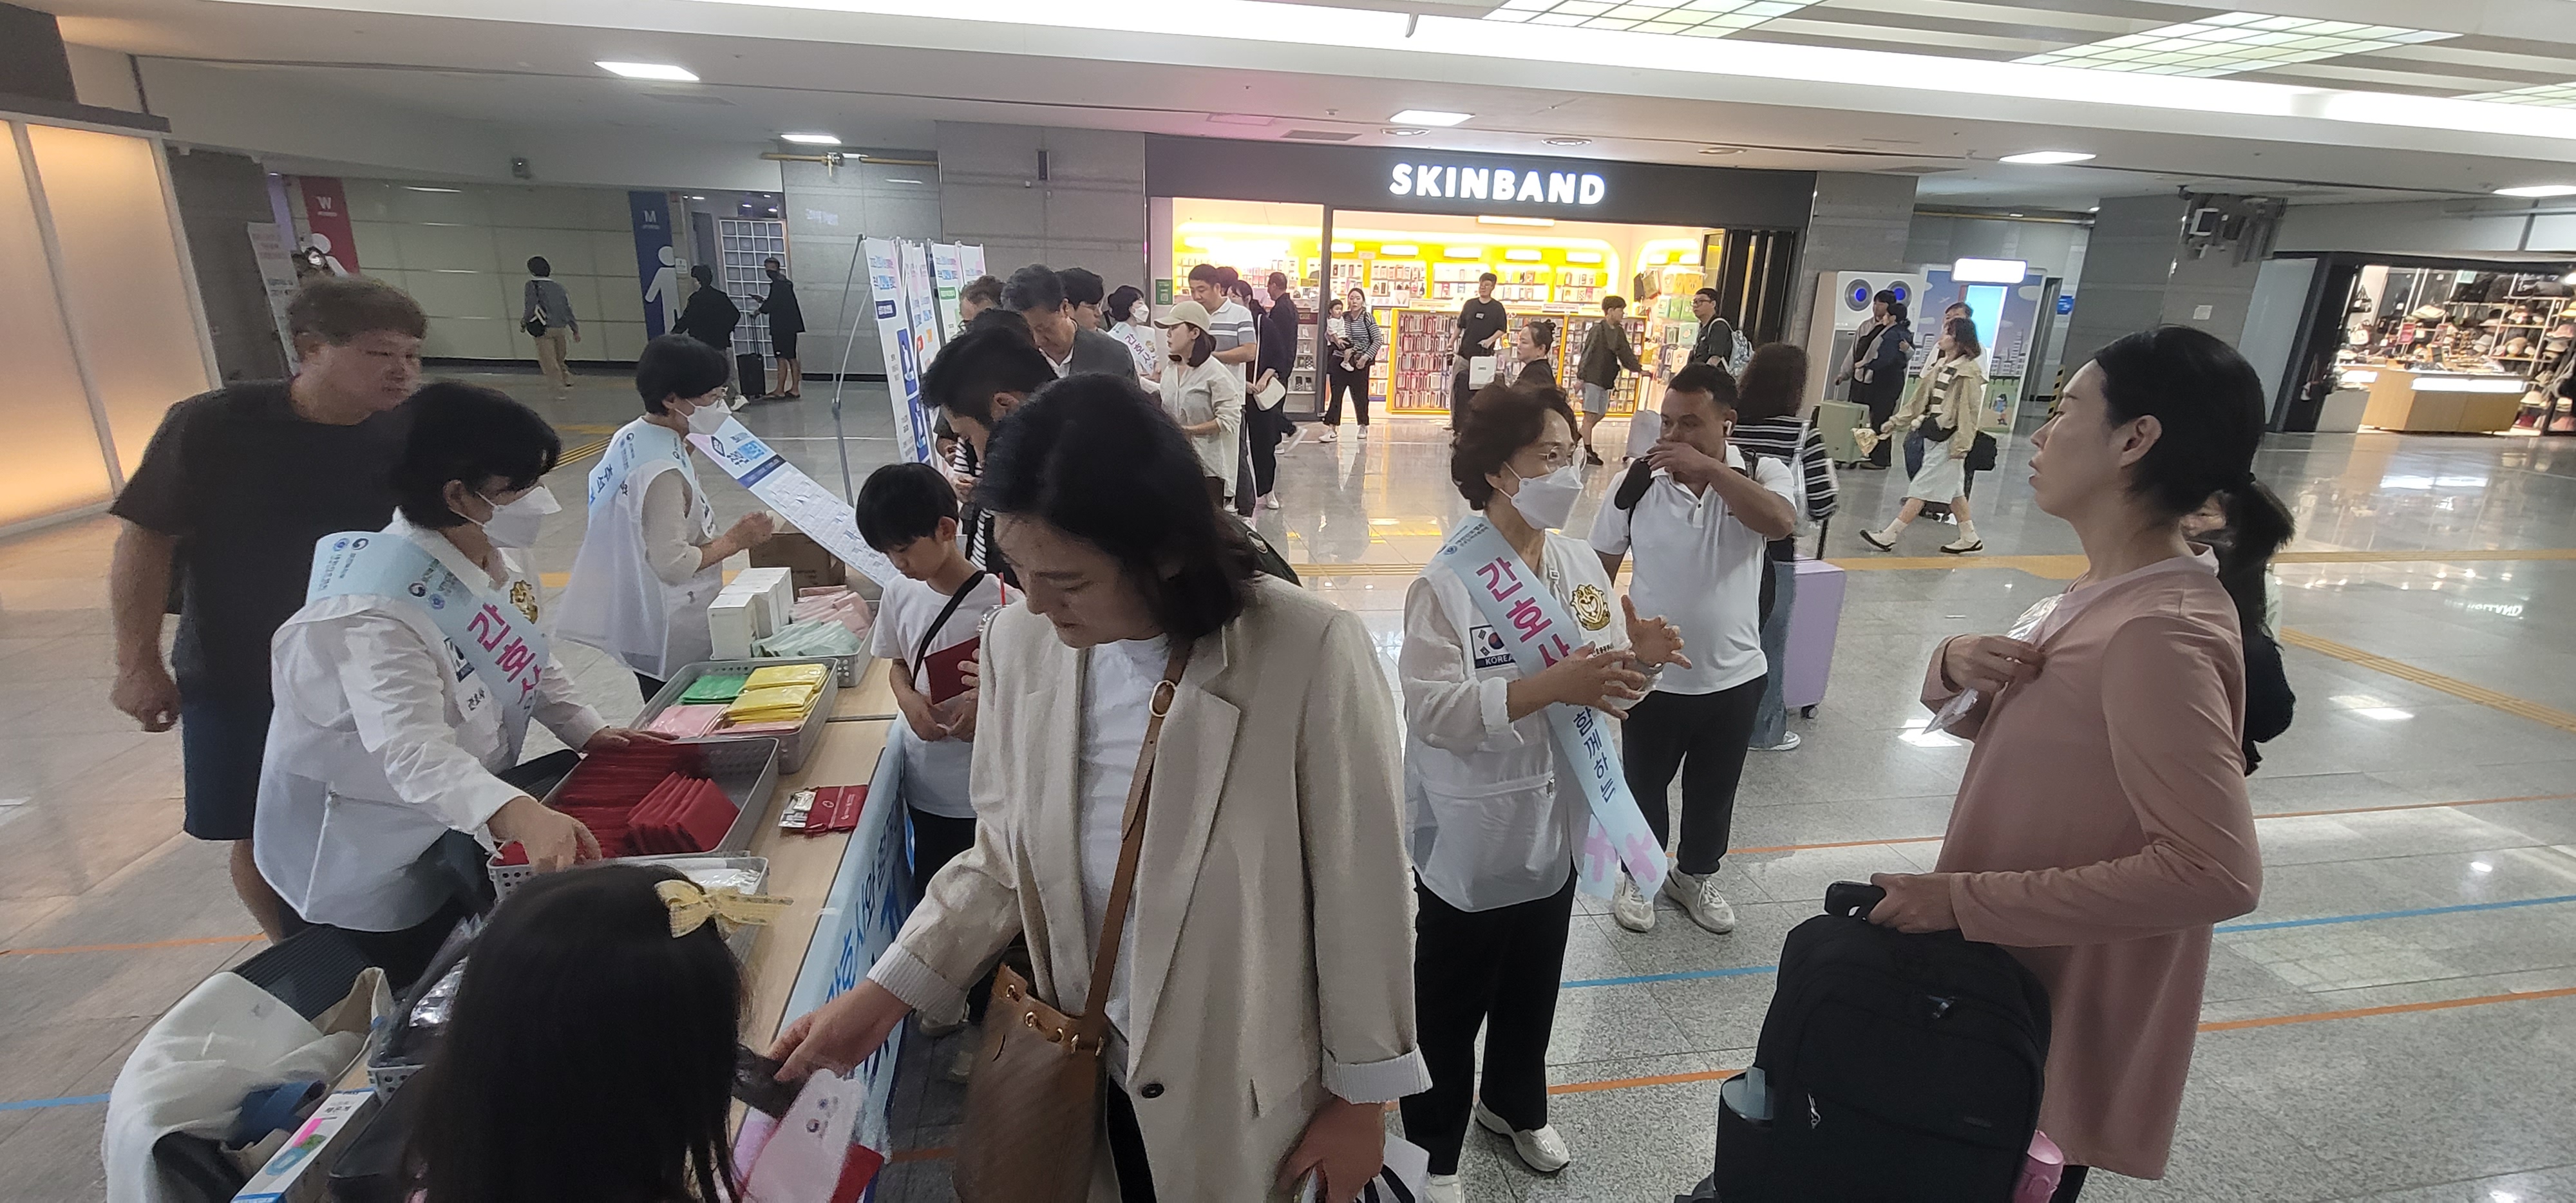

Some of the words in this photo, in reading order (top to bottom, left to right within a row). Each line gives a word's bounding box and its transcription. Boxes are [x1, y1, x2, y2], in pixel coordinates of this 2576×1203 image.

[316, 196, 332, 209] W
[1388, 163, 1605, 205] SKINBAND
[644, 210, 656, 223] M
[467, 602, 542, 705] 간호사
[1475, 556, 1571, 668] 간호사
[1573, 706, 1616, 804] 함께하는
